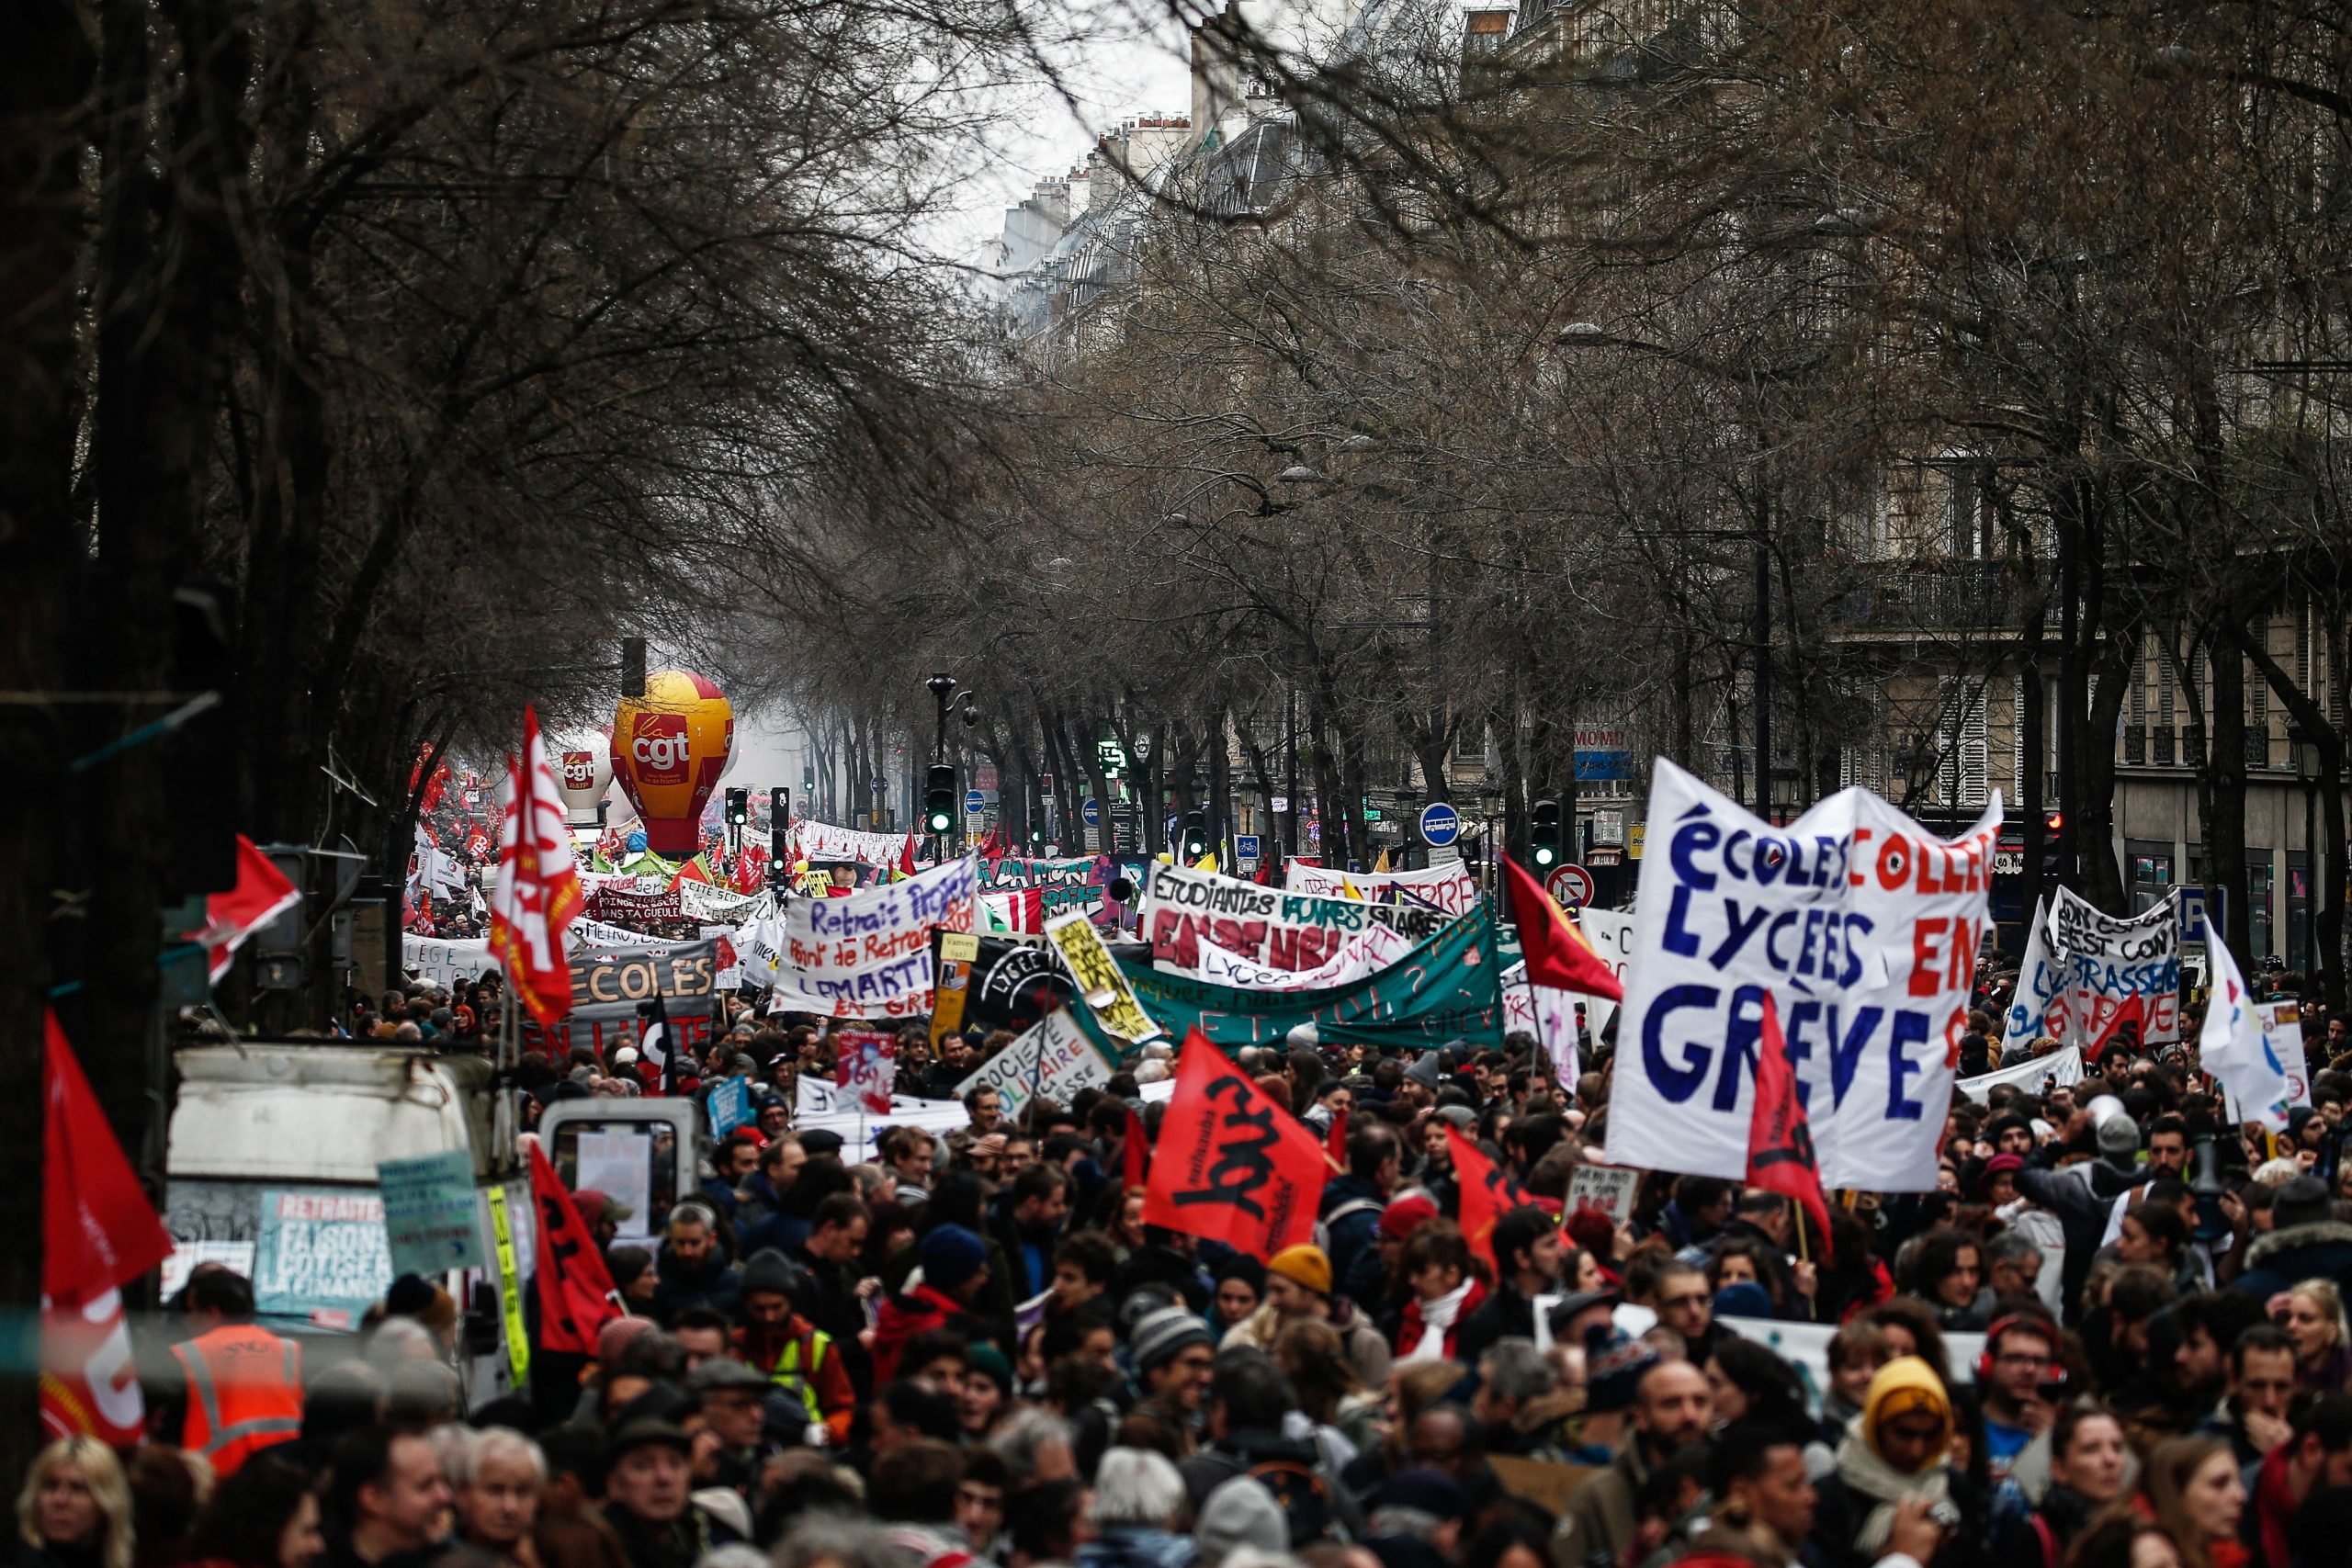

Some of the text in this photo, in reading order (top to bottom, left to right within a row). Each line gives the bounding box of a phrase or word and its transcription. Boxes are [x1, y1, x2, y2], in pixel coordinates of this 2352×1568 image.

[632, 731, 689, 771] cgt
[564, 761, 595, 782] cgt
[2185, 897, 2207, 932] P
